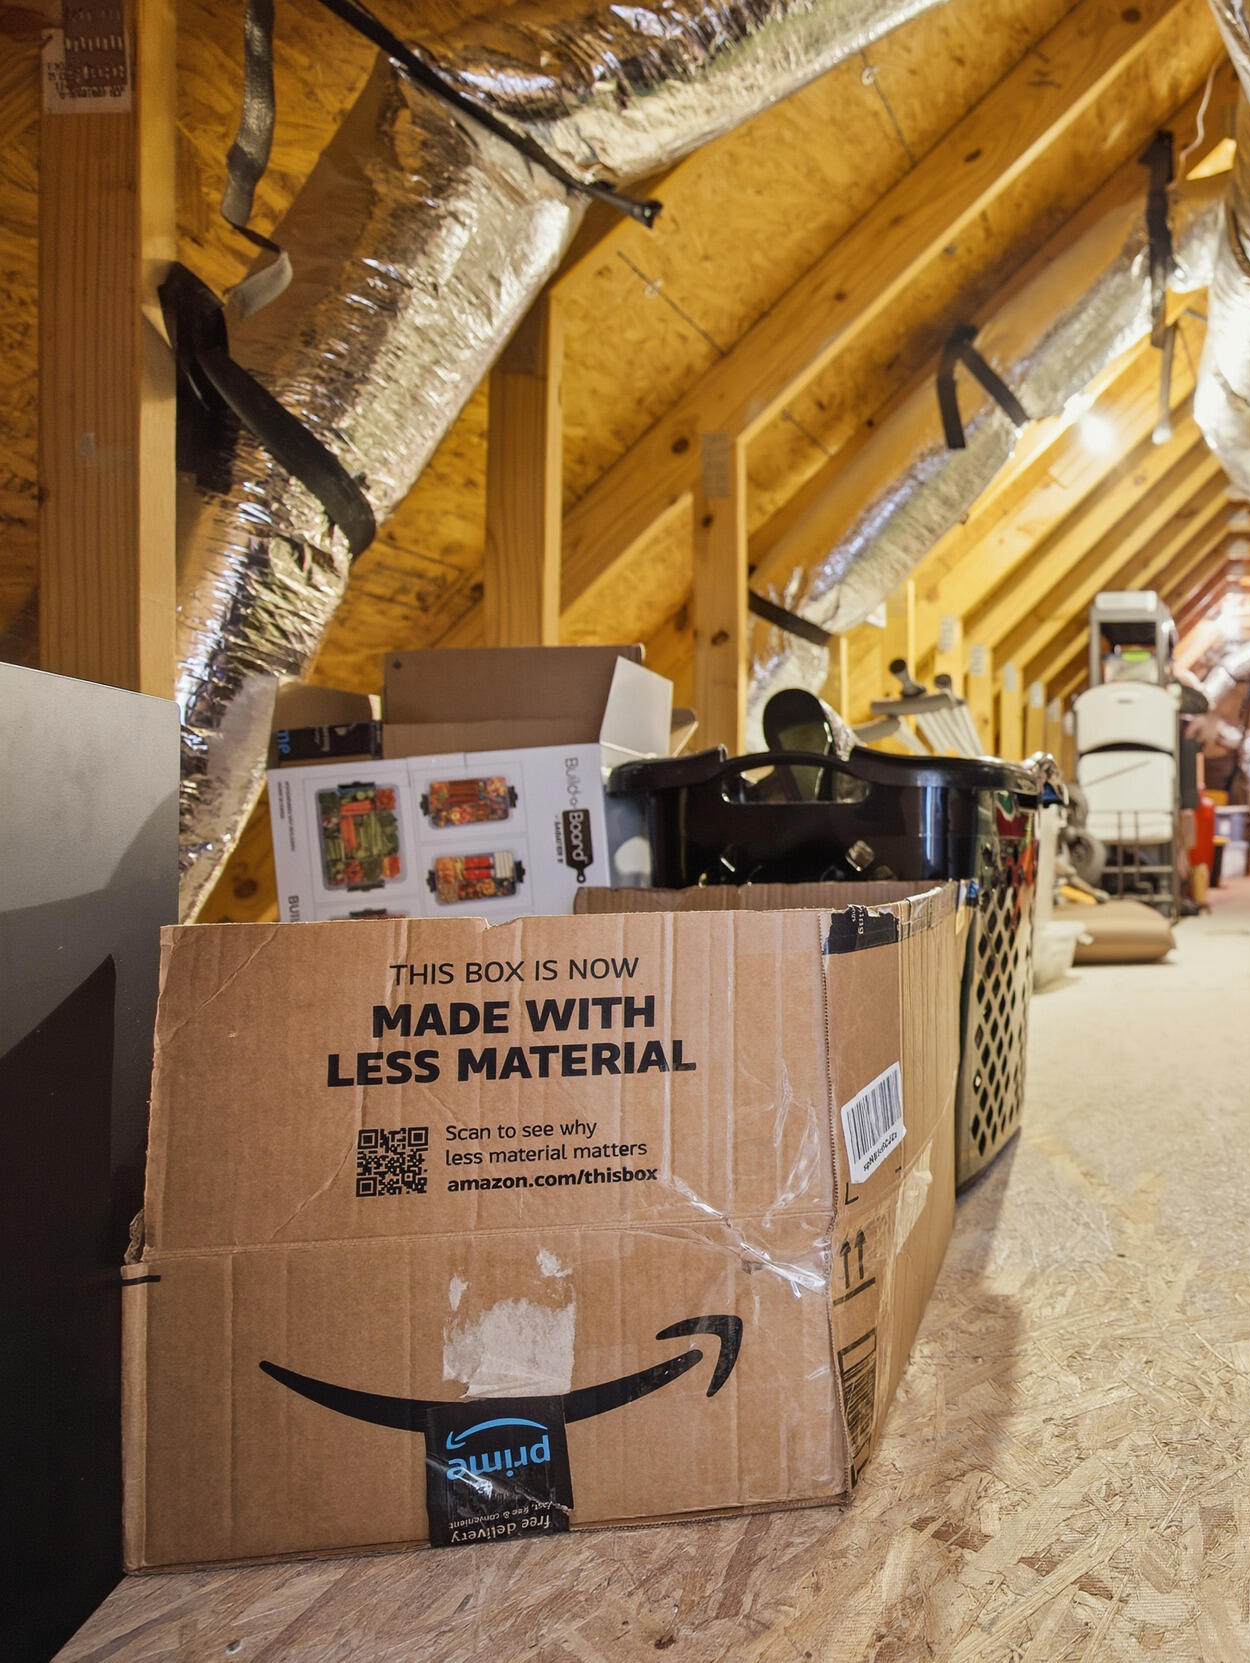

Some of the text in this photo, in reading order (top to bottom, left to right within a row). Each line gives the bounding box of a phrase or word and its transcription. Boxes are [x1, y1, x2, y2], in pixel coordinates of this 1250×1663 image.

[390, 957, 639, 985] THIS BOX IS NOW
[373, 995, 655, 1038] MADE WITH
[327, 1040, 697, 1087] LESS MATERIAL
[446, 1119, 597, 1141] Scan to see why
[445, 1143, 648, 1166] less material matters
[447, 1166, 658, 1192] amazon.com/thisbox
[447, 1434, 551, 1481] prime
[451, 1513, 551, 1544] free delivery
